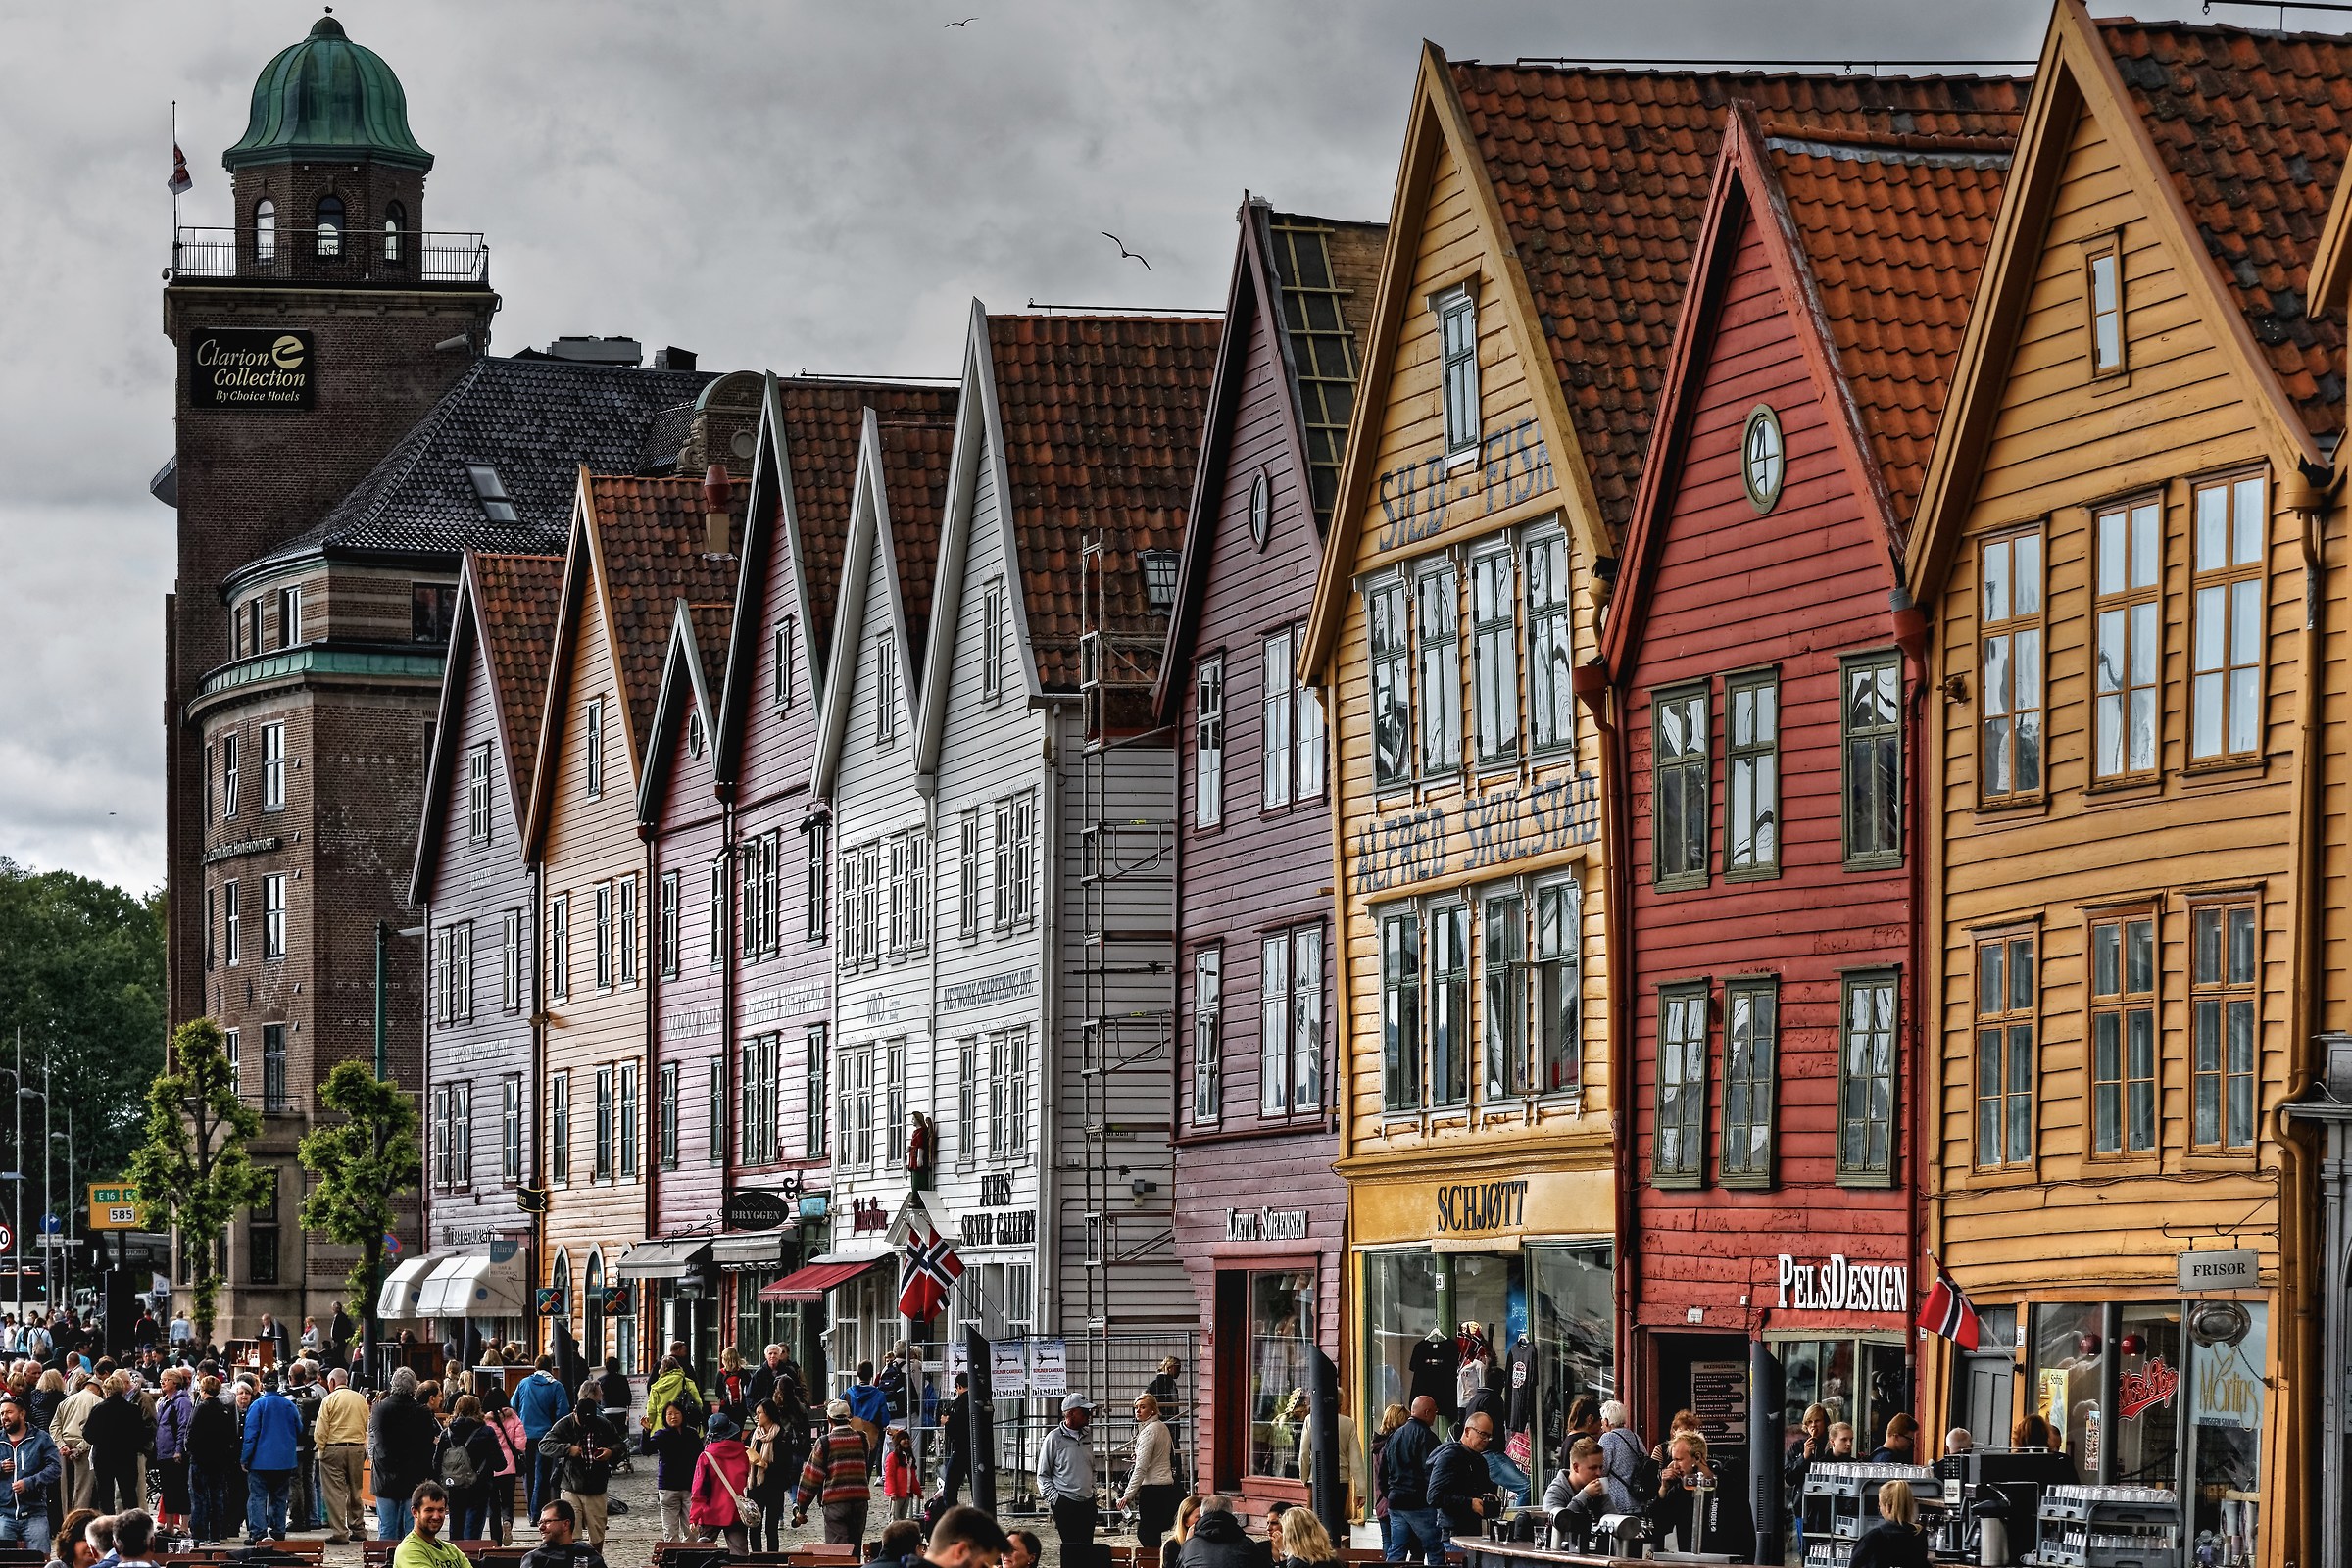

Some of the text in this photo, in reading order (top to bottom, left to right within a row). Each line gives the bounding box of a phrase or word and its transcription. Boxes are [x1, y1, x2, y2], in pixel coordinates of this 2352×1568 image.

[197, 339, 270, 366] Clarion
[214, 368, 306, 387] Collection
[216, 390, 300, 403] By Choice Hotels
[1380, 455, 1447, 552] SILD
[1357, 771, 1597, 894] ALFRED SKULSTAD
[107, 1192, 116, 1200] 16
[112, 1210, 133, 1220] 585
[731, 1210, 781, 1220] BRYGGEN
[1438, 1180, 1528, 1232] SCHJØTT
[997, 1210, 1036, 1246] GALLERY
[493, 1245, 513, 1253] filini
[2192, 1262, 2246, 1277] FRISØR
[1510, 1449, 1530, 1467] NORWA
